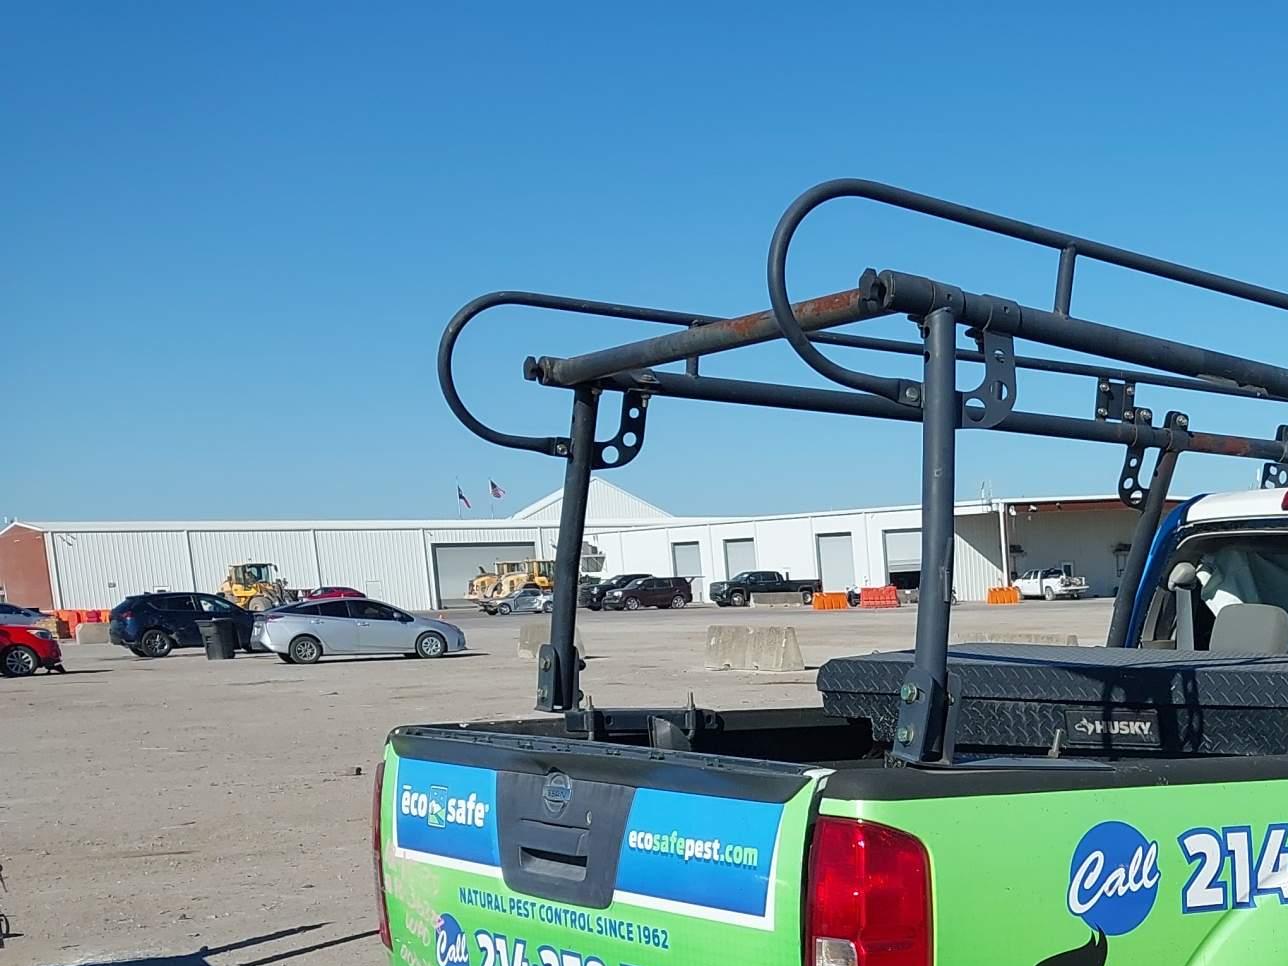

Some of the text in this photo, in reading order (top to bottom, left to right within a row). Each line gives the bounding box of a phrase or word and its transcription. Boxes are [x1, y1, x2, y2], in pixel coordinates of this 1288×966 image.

[1094, 720, 1151, 735] HUSKY
[628, 830, 758, 867] ecosafepest.com
[1069, 842, 1160, 915] Call
[459, 887, 669, 949] NATURAL PEST CONTROL SINCE 1962
